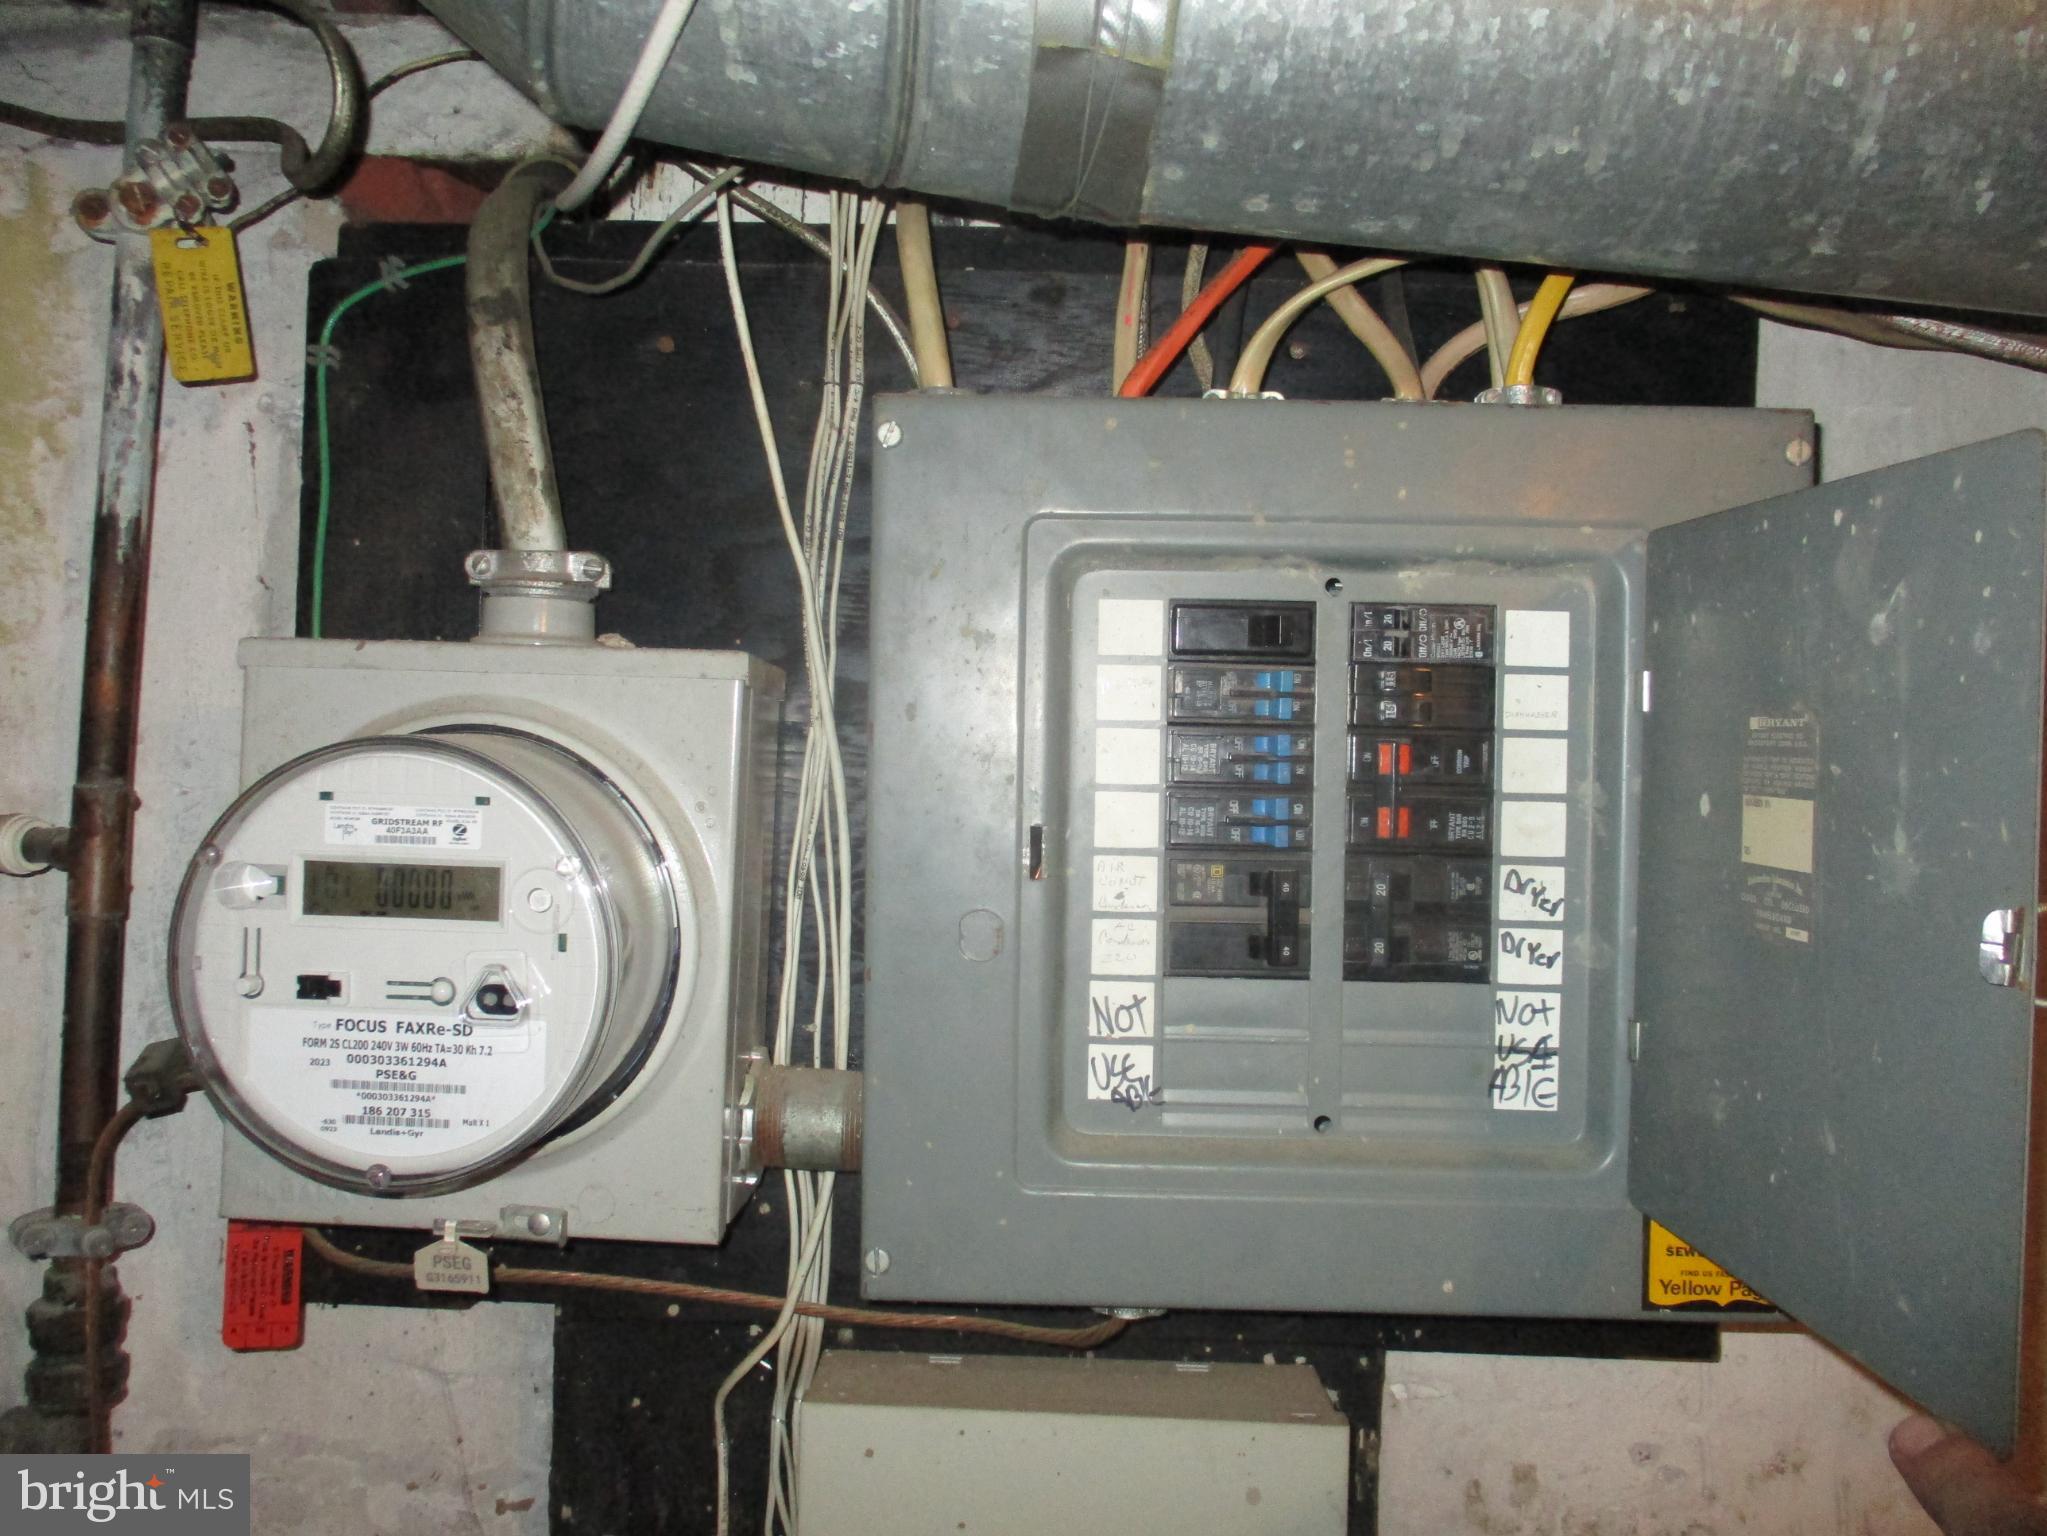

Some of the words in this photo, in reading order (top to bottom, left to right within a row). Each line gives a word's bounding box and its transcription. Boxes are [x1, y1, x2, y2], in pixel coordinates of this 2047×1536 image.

[226, 282, 243, 345] WARNING
[170, 315, 186, 372] SERVICE
[1382, 614, 1392, 625] 20
[1382, 640, 1393, 651] 20
[1759, 718, 1808, 727] BRYANT
[1209, 743, 1217, 773] BRYANT
[1229, 800, 1239, 814] OFF
[1293, 803, 1303, 815] ON
[371, 818, 430, 826] GRIDSTREAM
[1231, 827, 1240, 842] OFF
[1282, 882, 1290, 892] 40
[1376, 884, 1386, 896] 20
[1504, 867, 1564, 918] Dryer
[1282, 946, 1291, 956] 40
[1374, 942, 1384, 954] 20
[1501, 932, 1561, 970] Dryer
[336, 1018, 387, 1033] FOCUS
[396, 1021, 473, 1037] FAXRe-SD
[302, 1037, 327, 1048] FORM
[329, 1038, 340, 1049] 2S
[342, 1039, 369, 1050] CL200
[371, 1040, 393, 1051] 240V
[395, 1042, 408, 1052] 3W
[411, 1042, 432, 1053] 60Hz
[435, 1044, 463, 1054] TA=30
[466, 1044, 476, 1055] Kh
[479, 1046, 492, 1056] 7.2
[310, 1058, 330, 1066] 2023
[346, 1054, 447, 1068] 000303361294A
[376, 1070, 417, 1081] PSE&G
[362, 1106, 382, 1115] 186
[386, 1107, 407, 1116] 207
[411, 1108, 431, 1118] 315
[370, 1128, 424, 1138] Landis+Gyr
[433, 1255, 472, 1270] PSEG
[1660, 1280, 1722, 1295] Yellow
